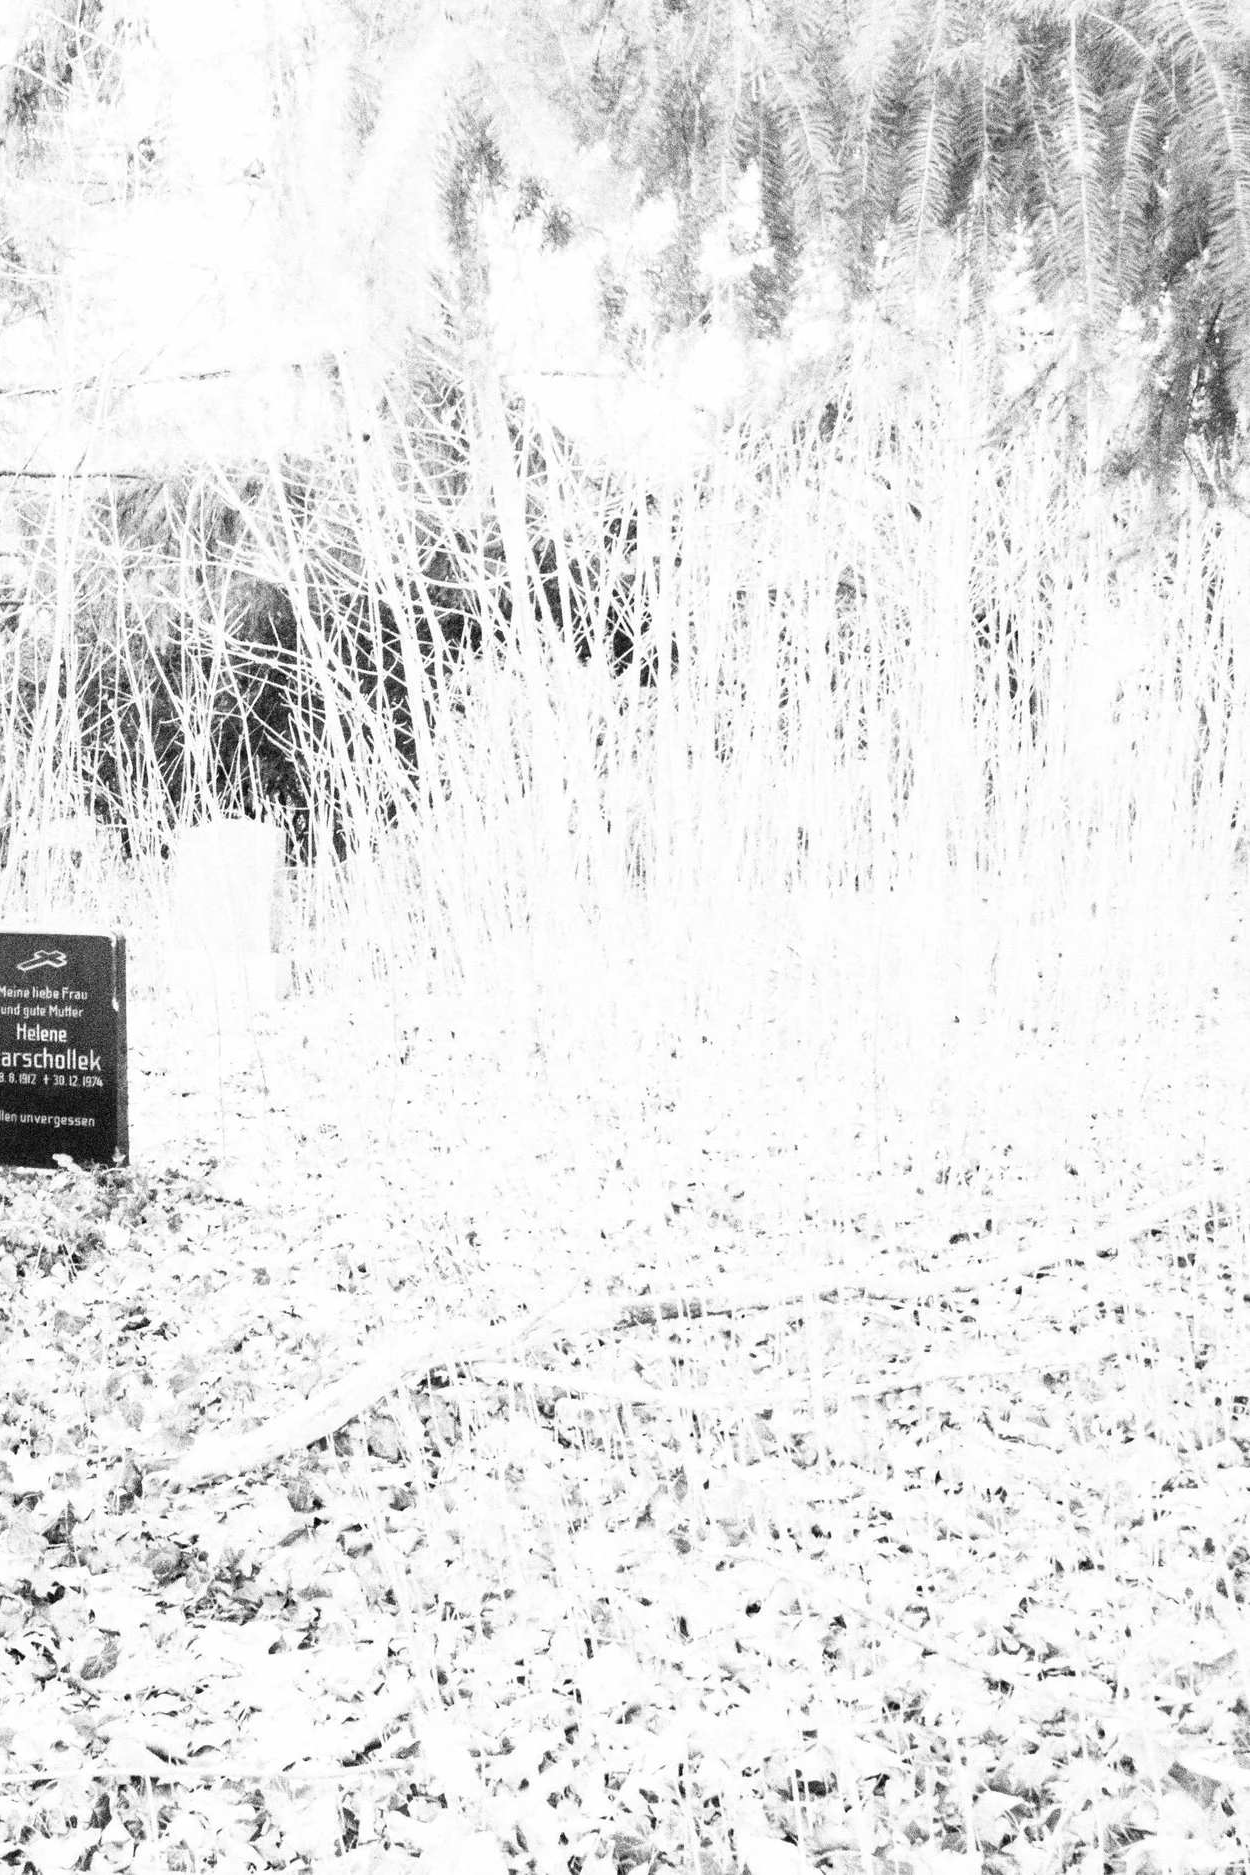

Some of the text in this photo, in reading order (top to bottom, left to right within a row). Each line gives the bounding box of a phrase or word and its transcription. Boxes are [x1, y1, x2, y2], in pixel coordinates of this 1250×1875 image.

[31, 986, 59, 999] liebe
[61, 986, 88, 1000] Frau
[0, 1003, 84, 1019] und gute Mutter
[16, 1022, 67, 1043] Helene
[19, 1113, 95, 1128] unvergessen
